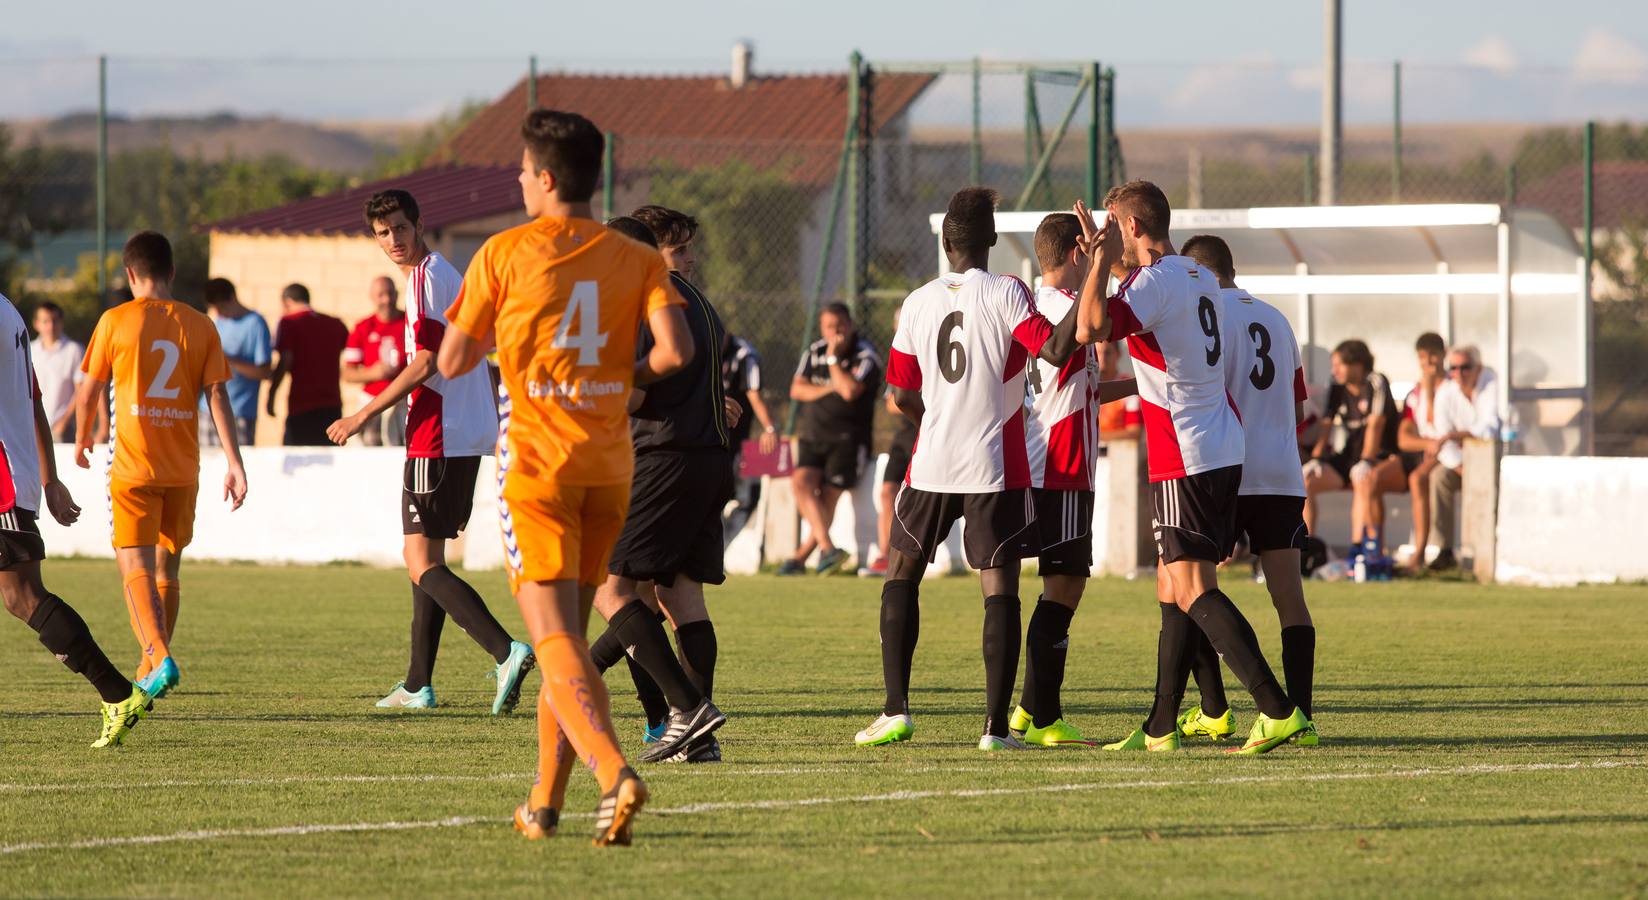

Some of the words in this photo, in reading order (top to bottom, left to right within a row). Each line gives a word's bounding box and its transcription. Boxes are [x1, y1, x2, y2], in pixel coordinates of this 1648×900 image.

[550, 280, 609, 366] 4
[937, 310, 966, 384] 6
[1198, 295, 1221, 367] 9
[1248, 321, 1276, 391] 3
[145, 339, 181, 399] 2
